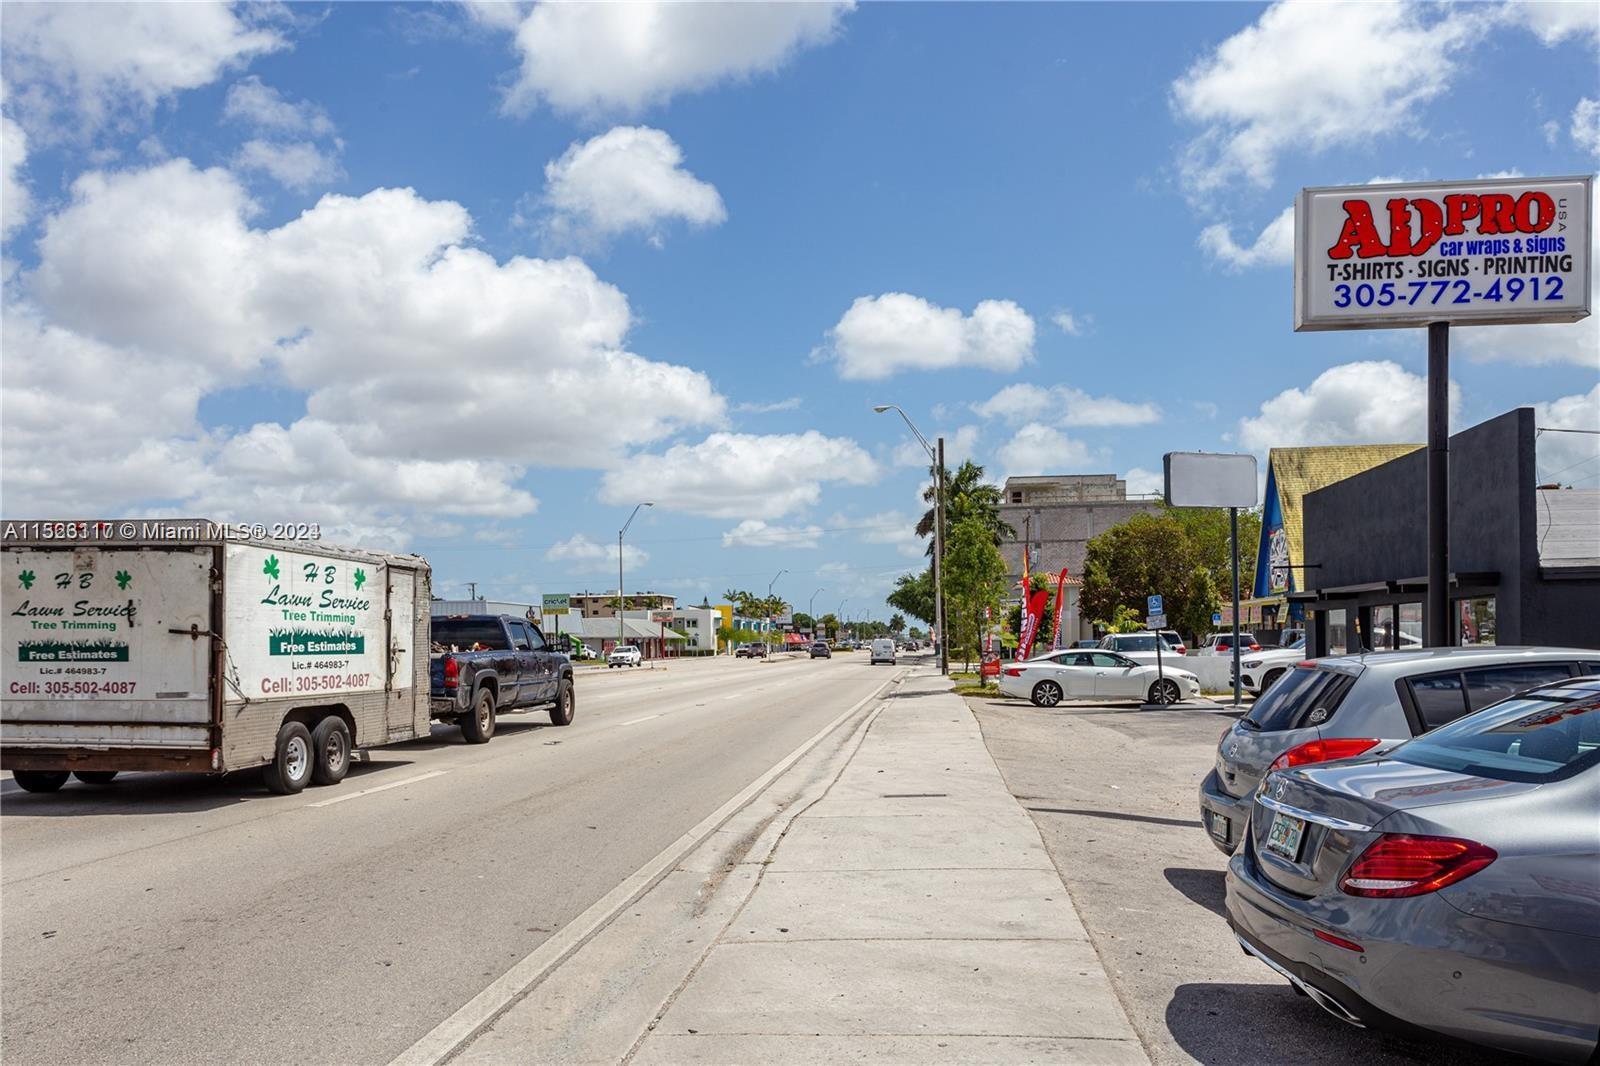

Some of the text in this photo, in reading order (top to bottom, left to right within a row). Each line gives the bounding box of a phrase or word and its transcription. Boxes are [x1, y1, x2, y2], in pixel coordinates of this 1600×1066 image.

[1558, 198, 1567, 232] USA
[1440, 235, 1565, 257] car wraps & signs
[1327, 254, 1572, 281] T-SHIRTS SIGNS PRINTING
[1334, 276, 1564, 308] 305-772-4912
[54, 572, 95, 590] H B
[303, 562, 336, 585] H B
[261, 584, 370, 610] Lawn Service
[11, 600, 138, 617] Lawn Service
[282, 609, 356, 625] Tree Trimming
[31, 620, 117, 631] Tree Trimming
[29, 650, 118, 660] Free Estimates
[280, 641, 357, 653] Free Estimates
[65, 667, 107, 675] 464983-7
[314, 660, 349, 669] 464983-7
[10, 682, 137, 694] Cell: 305-502-4087
[261, 673, 370, 694] Cell: 305-502-4087
